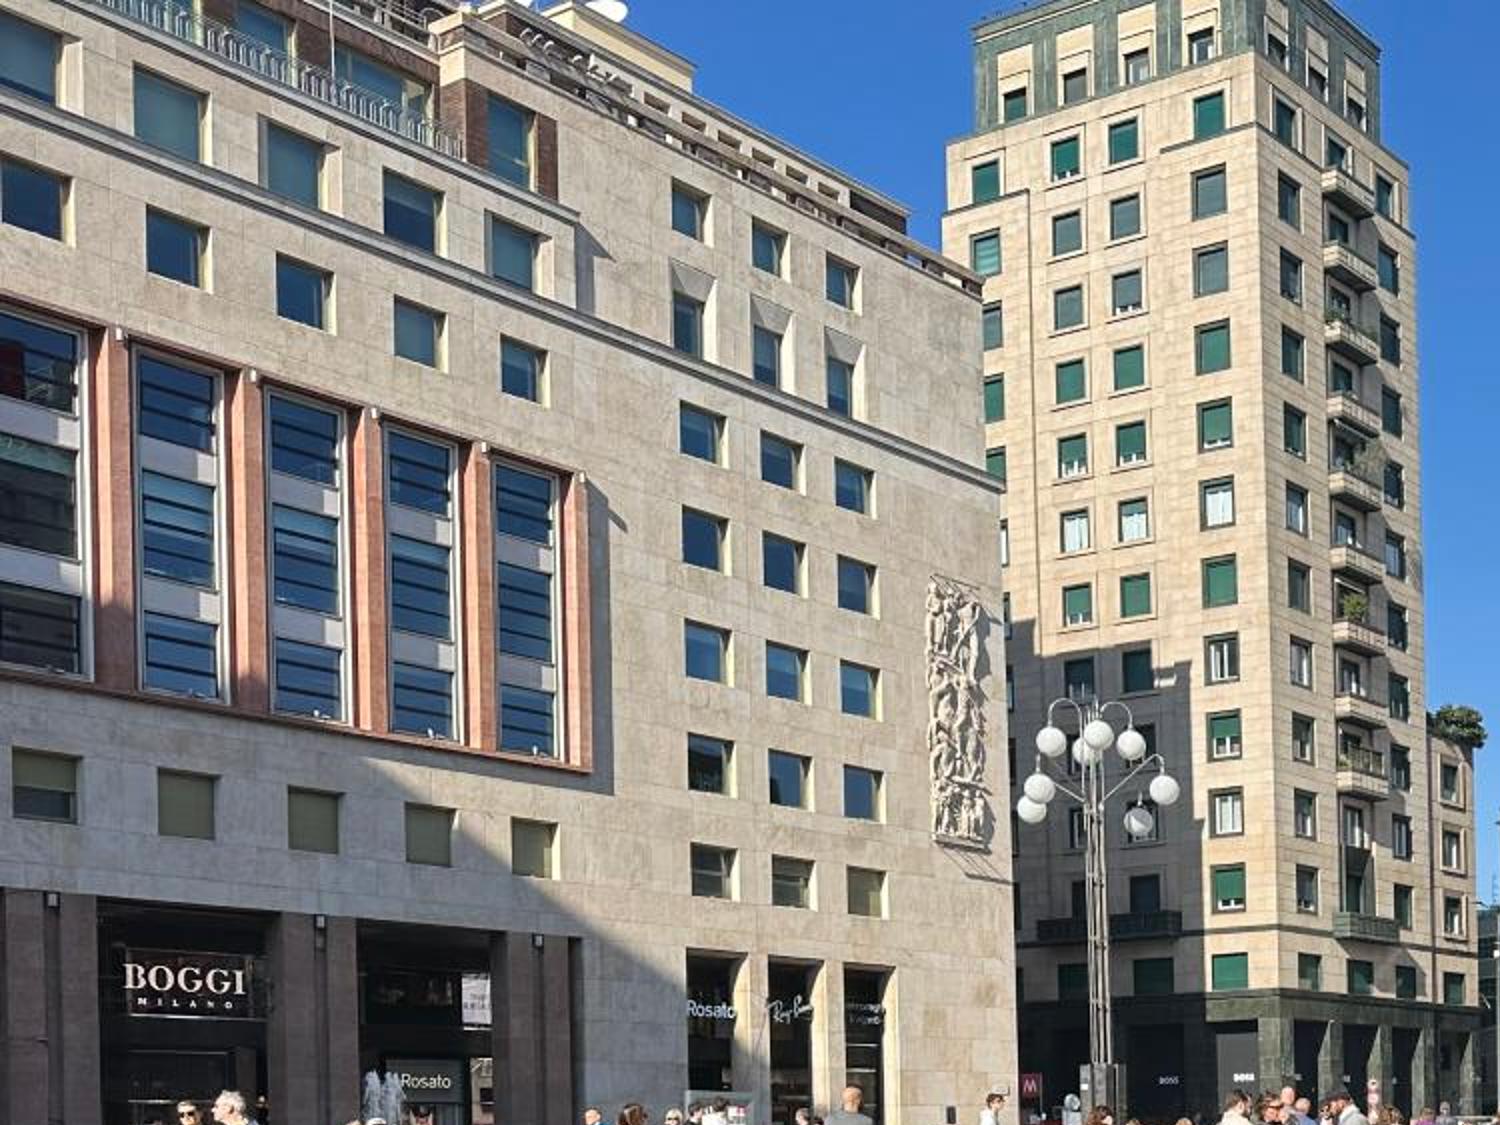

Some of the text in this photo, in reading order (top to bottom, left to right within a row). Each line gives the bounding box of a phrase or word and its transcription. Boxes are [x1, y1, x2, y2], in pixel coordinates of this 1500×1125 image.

[123, 963, 247, 995] BOGGI
[137, 997, 233, 1010] MILANO
[687, 999, 737, 1019] Rosato
[401, 1072, 452, 1089] Rosato
